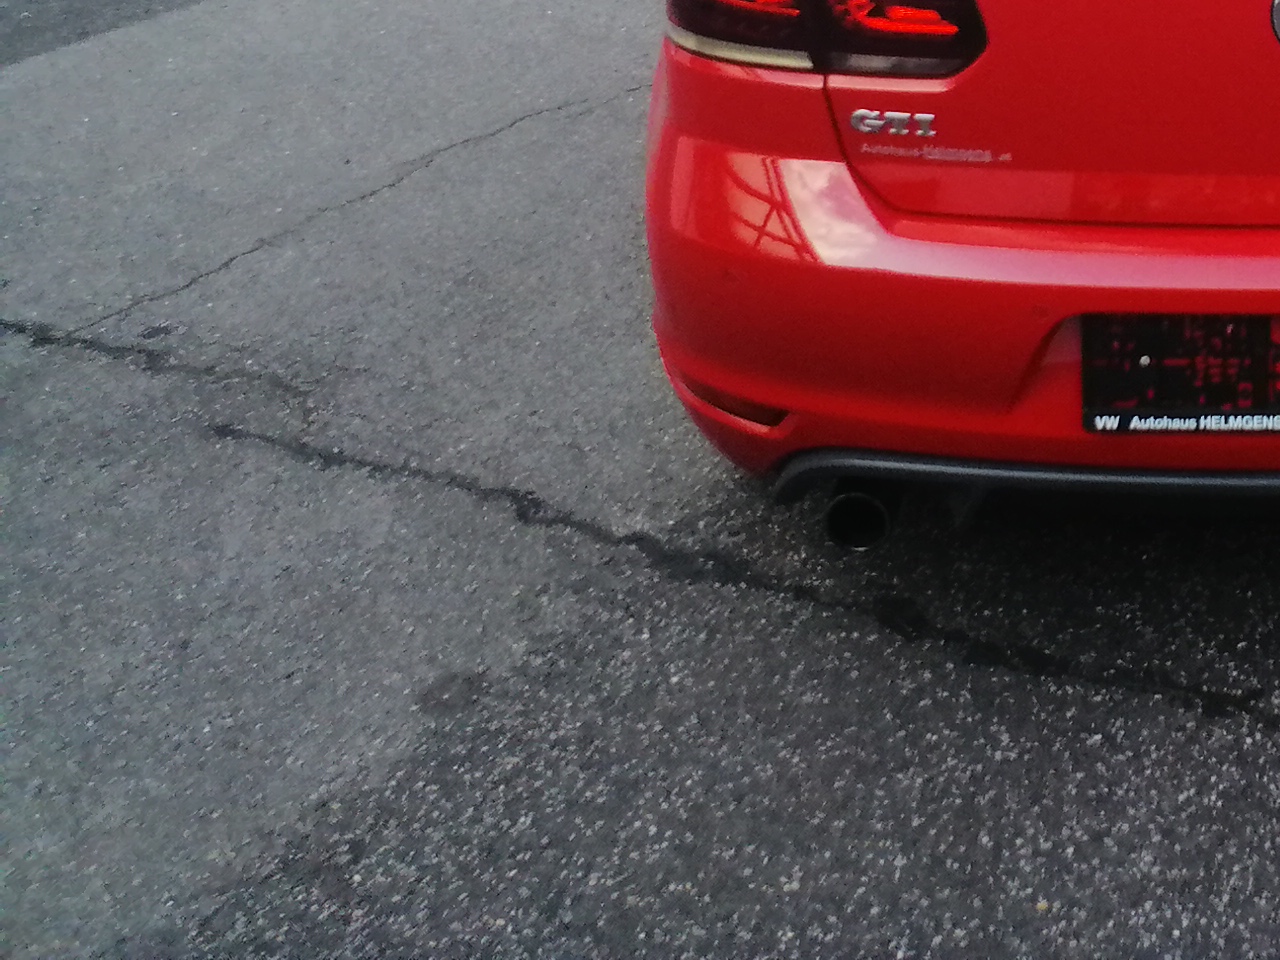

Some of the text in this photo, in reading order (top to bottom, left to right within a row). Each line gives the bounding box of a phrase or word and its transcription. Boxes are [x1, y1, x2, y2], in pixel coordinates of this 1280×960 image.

[850, 108, 937, 137] GTI
[1094, 415, 1120, 431] VW
[1129, 415, 1198, 431] Autohaus
